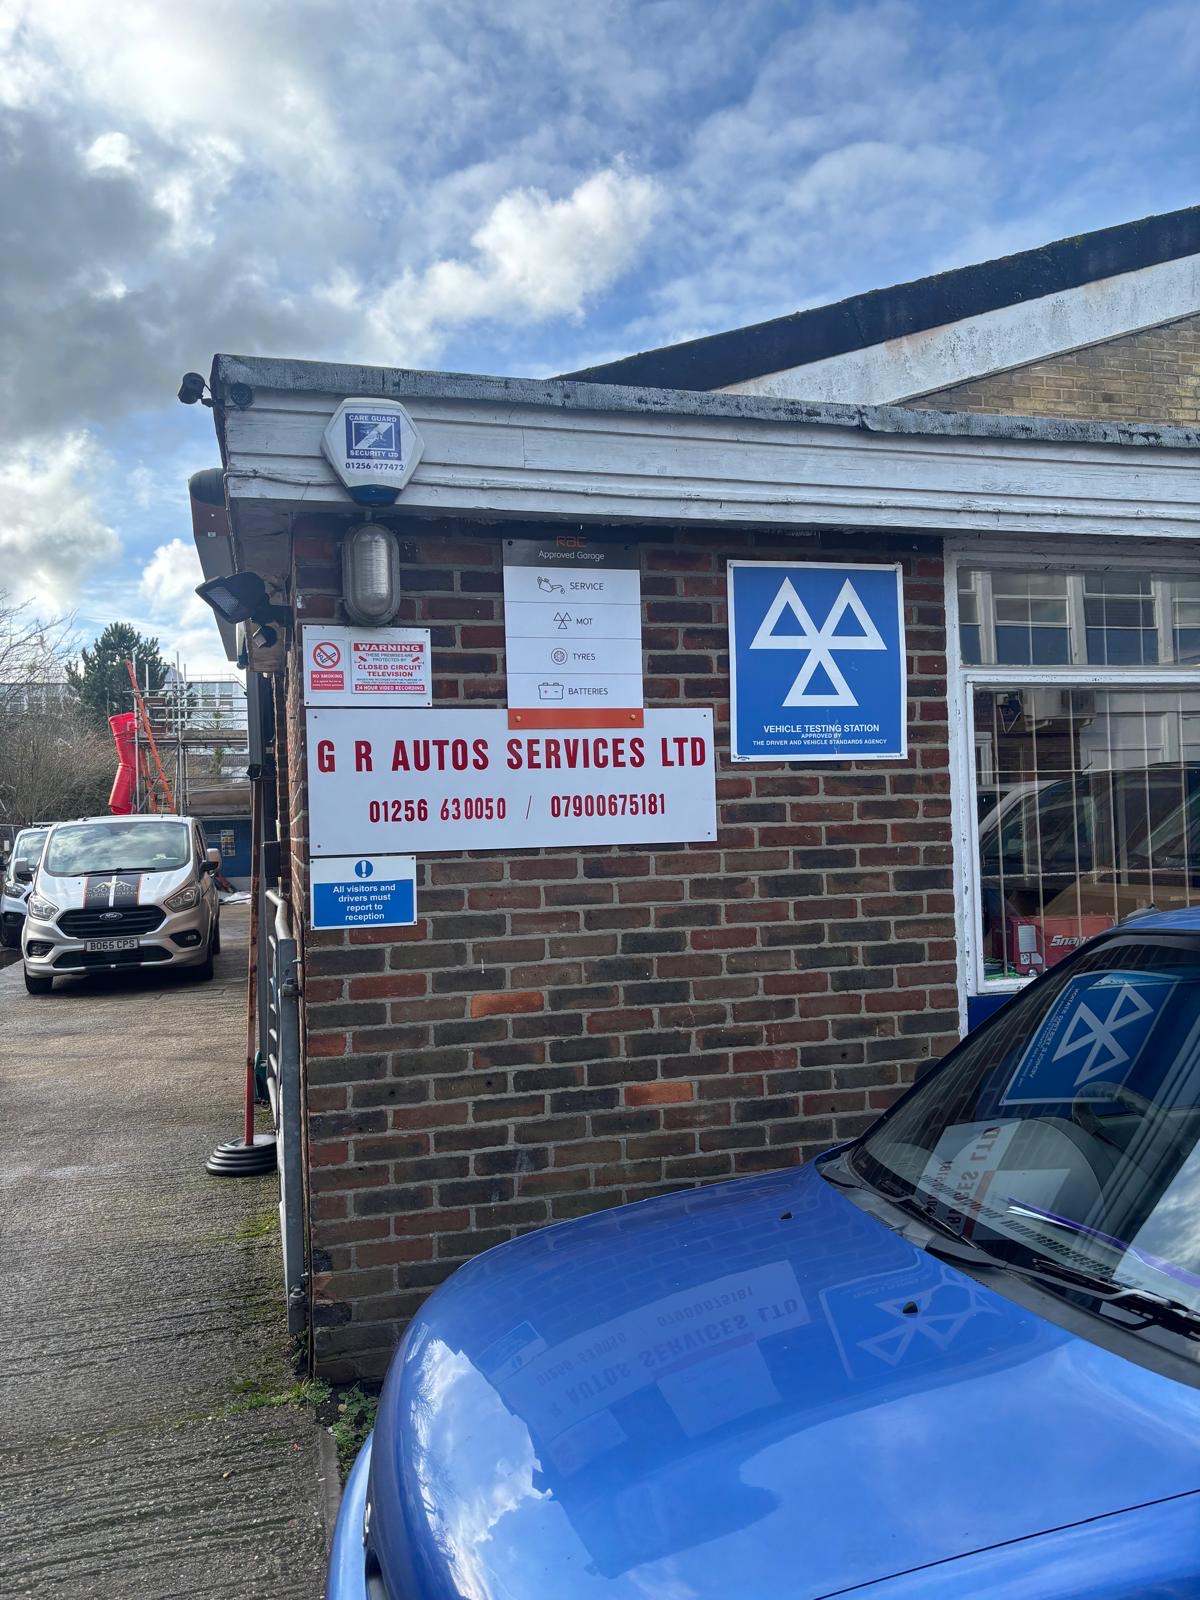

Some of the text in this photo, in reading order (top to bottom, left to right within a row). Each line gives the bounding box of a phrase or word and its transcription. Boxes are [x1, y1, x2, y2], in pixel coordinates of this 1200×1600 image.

[371, 415, 397, 423] GUARD
[350, 449, 386, 457] SECURITY
[345, 462, 404, 471] 01256 477472
[556, 536, 588, 548] RAC
[538, 550, 605, 562] Approved Garage
[569, 582, 604, 591] SERVICE
[576, 617, 593, 626] MOT
[358, 643, 420, 652] WARNING
[572, 653, 596, 661] TYRES
[568, 687, 609, 696] BATTERIES
[763, 724, 880, 733] VEHICLE TESTING STATION
[317, 737, 706, 773] G R AUTOS SERVICES LTD
[369, 793, 665, 823] 01256 630050 / 07900675181
[333, 883, 396, 894] All visitors and
[338, 893, 391, 903] drivers must
[346, 903, 383, 913] report to
[345, 912, 385, 922] reception
[116, 939, 135, 949] CPS
